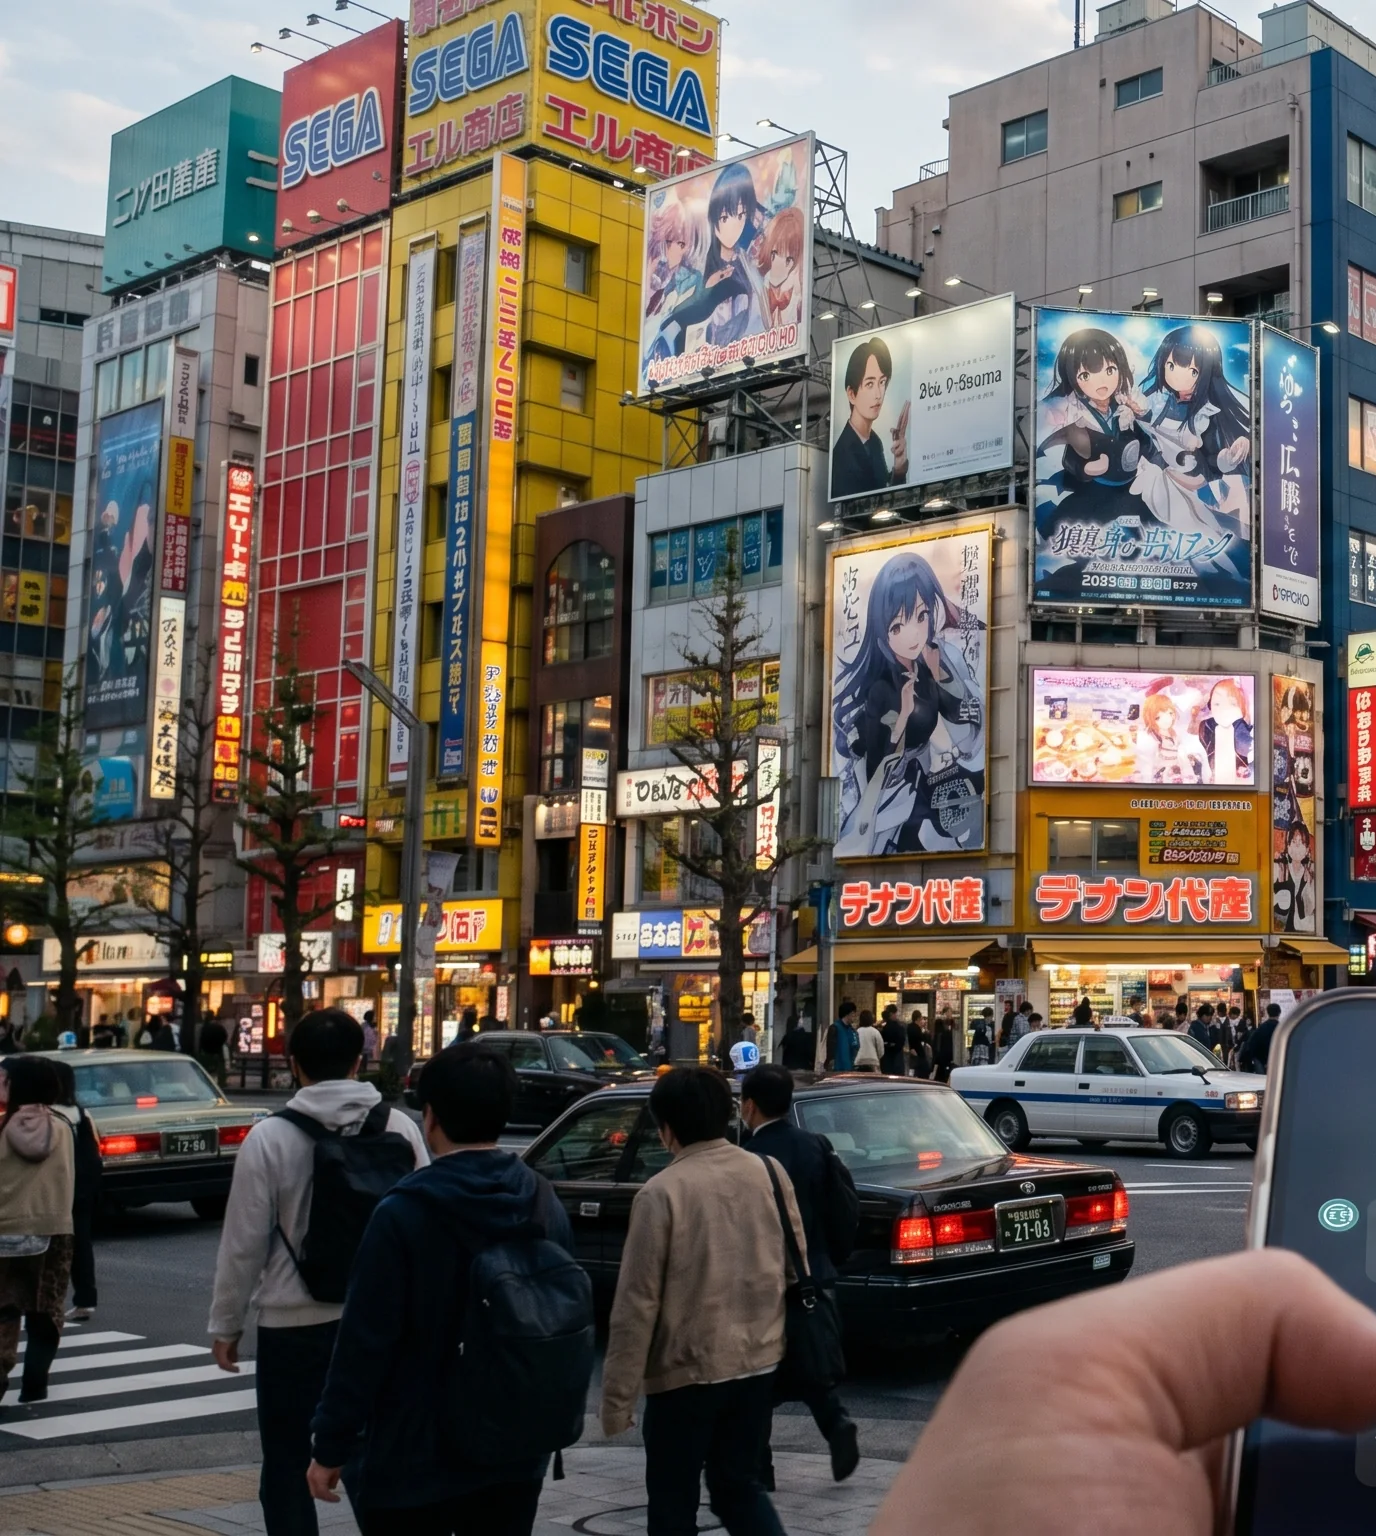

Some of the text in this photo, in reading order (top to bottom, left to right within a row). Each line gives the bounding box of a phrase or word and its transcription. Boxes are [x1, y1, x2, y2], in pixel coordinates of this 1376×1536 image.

[408, 11, 529, 117] SEGA
[546, 13, 713, 137] SEGA
[281, 87, 386, 190] SEGA
[404, 92, 524, 178] エル商店
[840, 876, 984, 927] デナン代産
[1036, 875, 1253, 923] デナン代産
